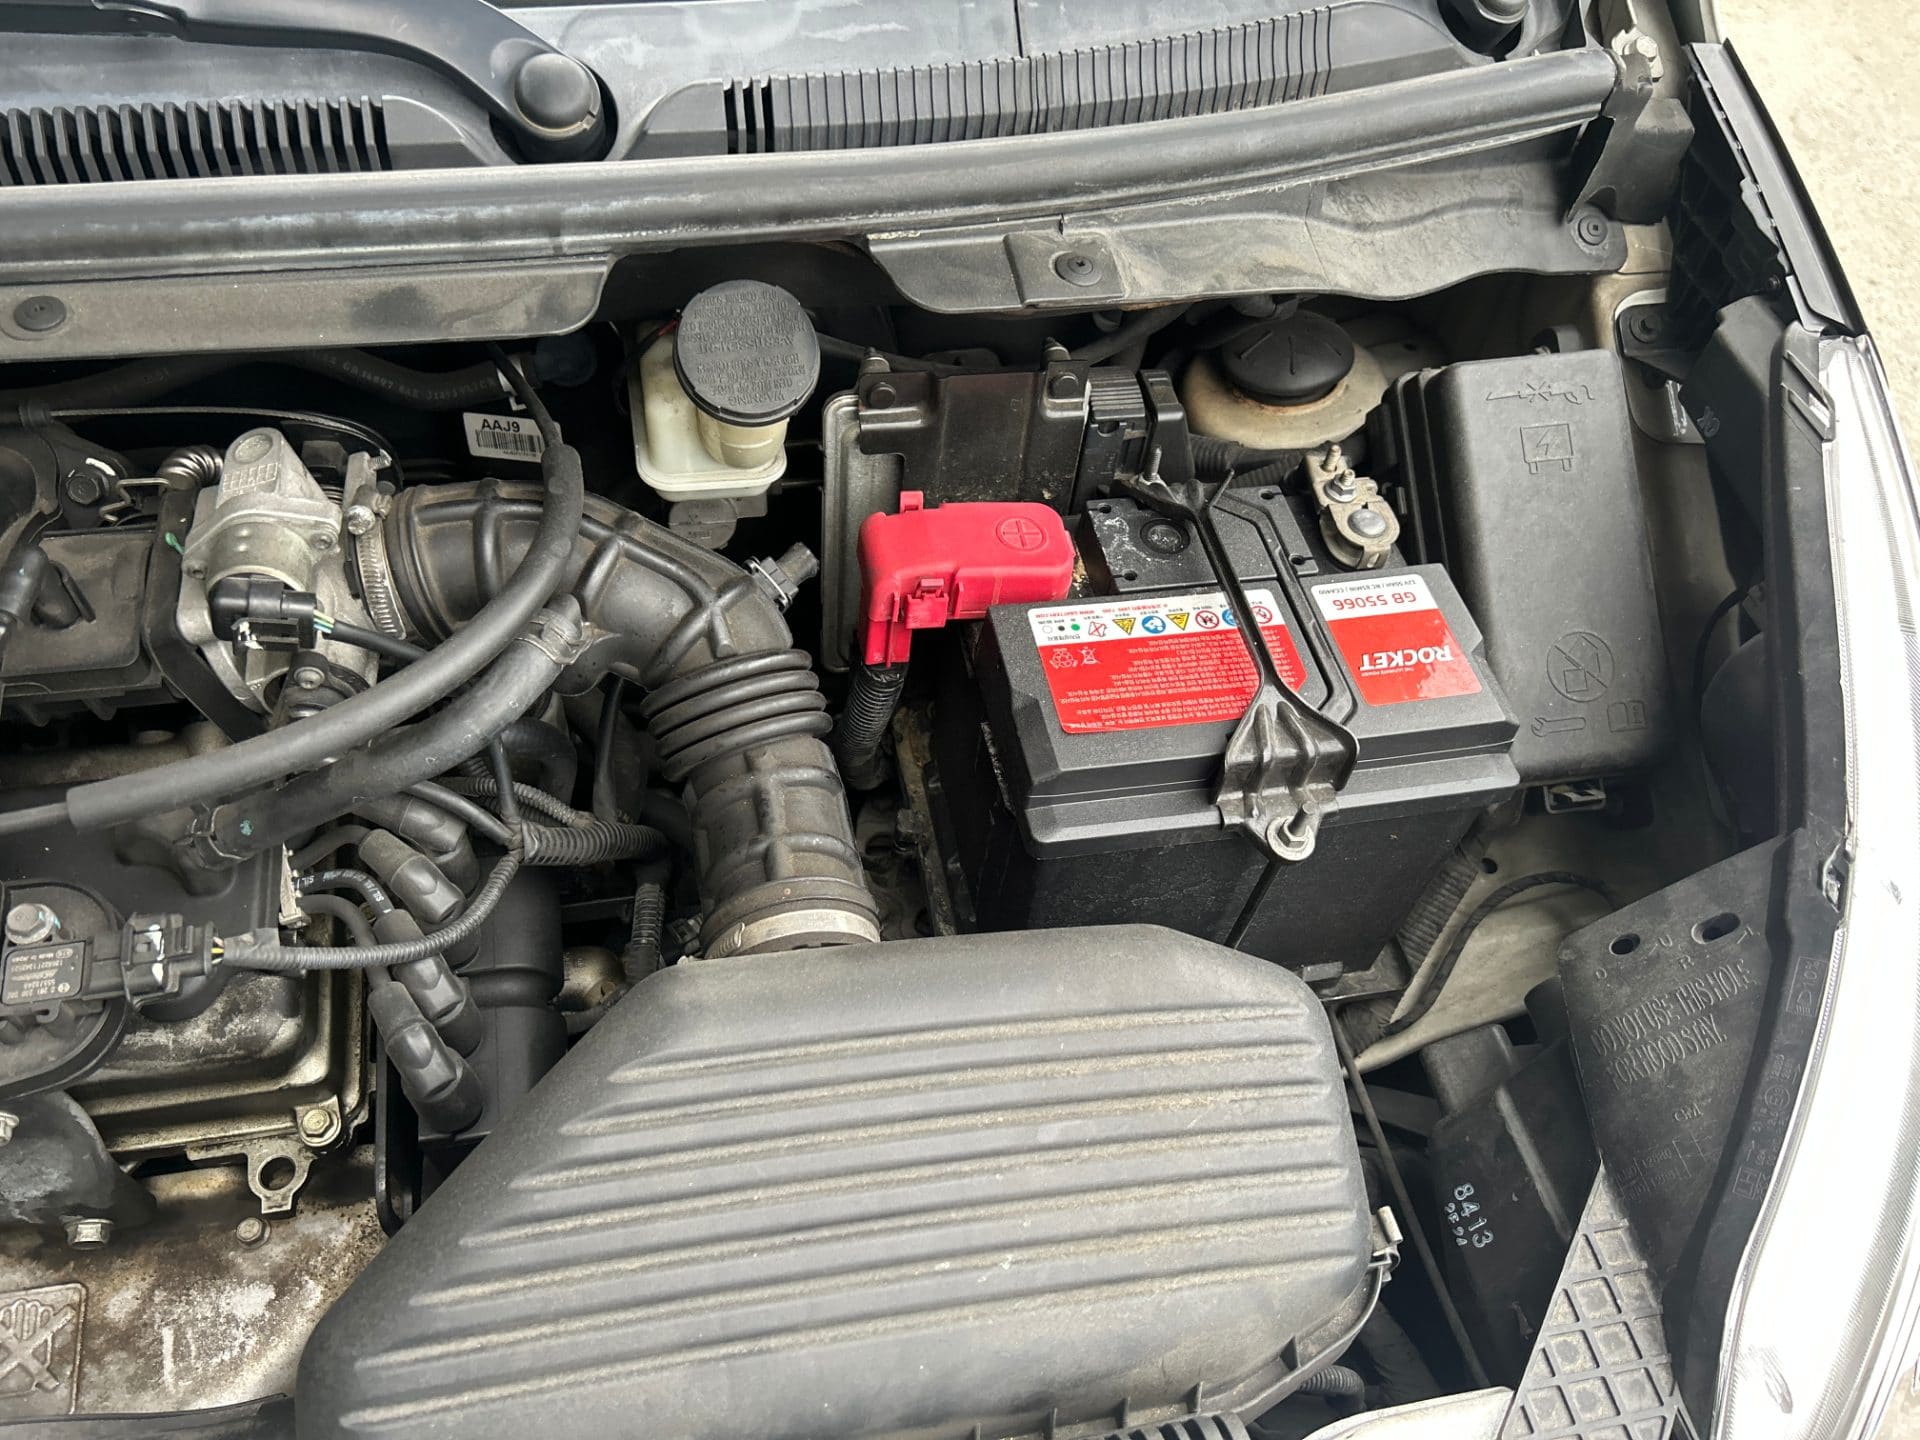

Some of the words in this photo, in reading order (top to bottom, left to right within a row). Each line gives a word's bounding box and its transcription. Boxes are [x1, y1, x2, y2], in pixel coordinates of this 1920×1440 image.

[481, 418, 520, 433] AAJ9
[1333, 594, 1387, 611] 55066
[1392, 591, 1417, 604] GB
[1360, 645, 1455, 671] ROCKET
[1609, 1008, 1647, 1051] NOT
[1640, 993, 1681, 1030] USE
[1675, 977, 1714, 1016] THIS
[1705, 959, 1757, 1001] HOLE
[1635, 1031, 1686, 1073] HOOD
[1454, 1183, 1494, 1248] 8413
